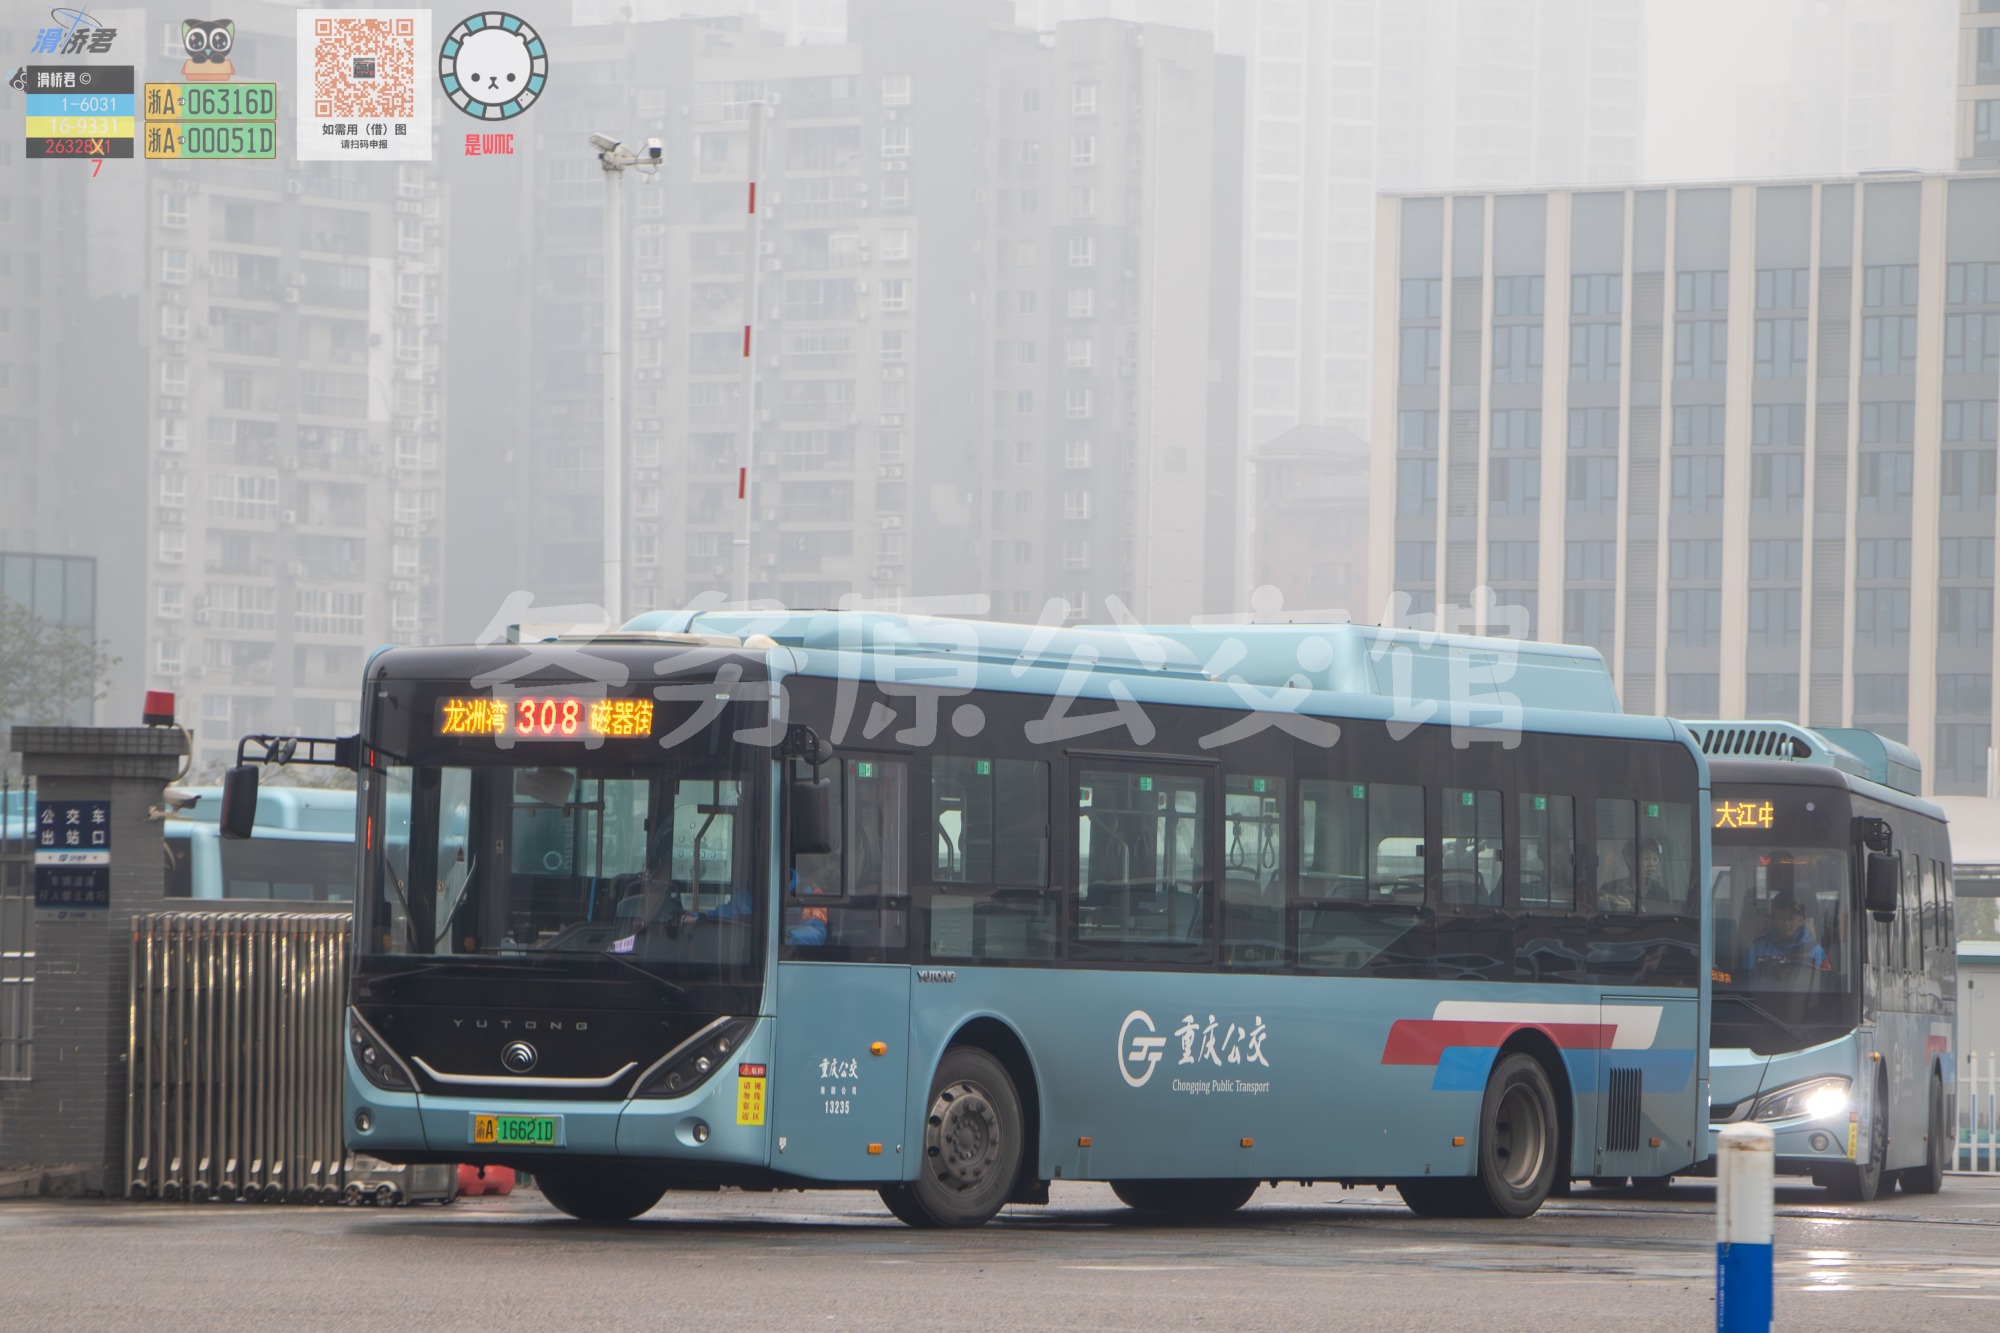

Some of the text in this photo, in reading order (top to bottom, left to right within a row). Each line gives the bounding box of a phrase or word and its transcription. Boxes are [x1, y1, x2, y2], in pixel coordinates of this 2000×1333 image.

[442, 699, 654, 735] 龙洲湾 308 磁器街
[41, 808, 106, 825] 公交车
[41, 829, 105, 845] 出站口
[917, 970, 957, 983] YUTONG
[453, 1019, 588, 1031] YUTONG
[1174, 1014, 1270, 1067] 重庆公交
[819, 1058, 859, 1079] 重庆公交
[1172, 1078, 1270, 1096] Chongqing Public Transport
[825, 1100, 850, 1114] 13235
